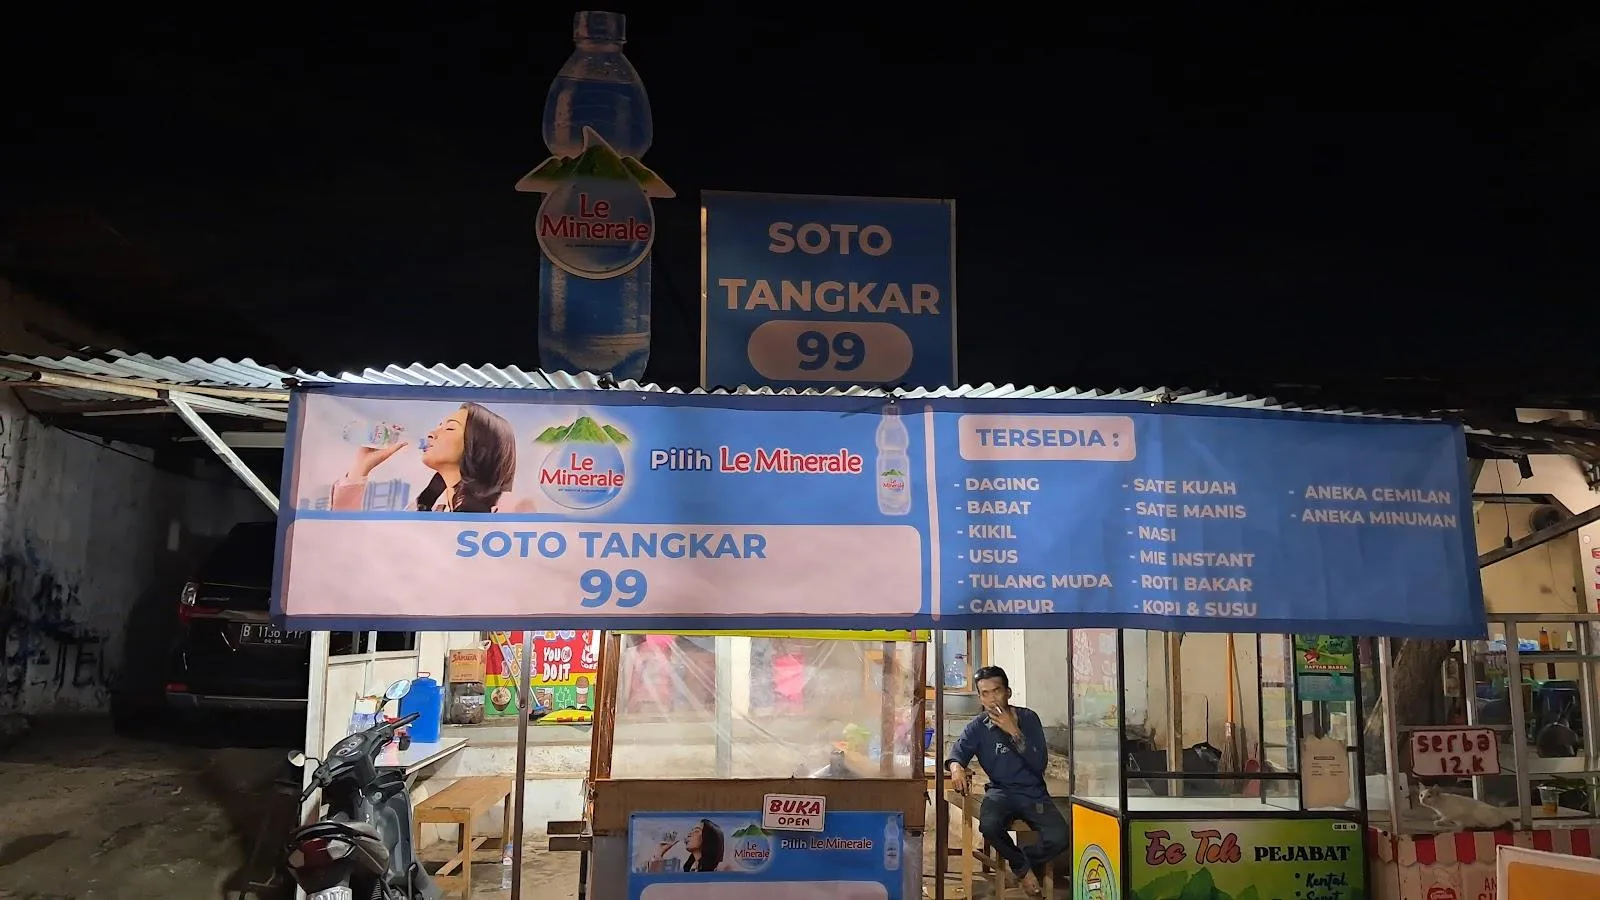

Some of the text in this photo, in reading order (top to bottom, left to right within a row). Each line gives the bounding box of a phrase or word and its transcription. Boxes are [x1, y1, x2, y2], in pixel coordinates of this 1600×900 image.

[581, 193, 609, 218] Le
[541, 215, 649, 240] Minerale
[769, 222, 892, 256] SOTO
[719, 278, 940, 315] TANGKAR
[797, 330, 866, 371] 99
[975, 428, 1106, 447] TERSEDIA
[571, 453, 593, 470] Le
[651, 447, 863, 473] Pilih Le Minerale
[540, 469, 624, 486] Minerale
[965, 477, 1040, 491] DAGING
[1134, 478, 1237, 495] SATE KUAH
[1305, 485, 1451, 505] ANEKA CEMILAN
[967, 501, 1031, 514] BABAT
[1136, 502, 1246, 519] SATE MANIS
[1302, 508, 1457, 529] ANEKA MINUMAN
[968, 525, 1017, 539] KIKIL
[1139, 526, 1176, 542] NASI
[456, 530, 768, 559] SOTO TANGKAR
[969, 550, 1018, 564] USUS
[1140, 550, 1255, 568] MIE INSTANT
[580, 569, 647, 608] 99
[969, 574, 1113, 589] TULANG MUDA
[1141, 574, 1253, 592] ROTI BAKAR
[970, 599, 1054, 614] CAMPUR
[1143, 600, 1258, 617] KOPI & SUSU
[243, 625, 251, 637] B
[543, 647, 560, 661] YOU
[543, 662, 571, 682] DO IT
[1417, 733, 1490, 753] serba
[769, 799, 821, 815] BUKA
[778, 817, 810, 826] OPEN
[747, 842, 757, 850] Le
[781, 837, 872, 850] Pilih Le Minerale
[1190, 829, 1241, 864] Teh
[1254, 846, 1351, 862] PEJABAT
[734, 849, 770, 859] Minerale
[1306, 872, 1347, 890] Kental
